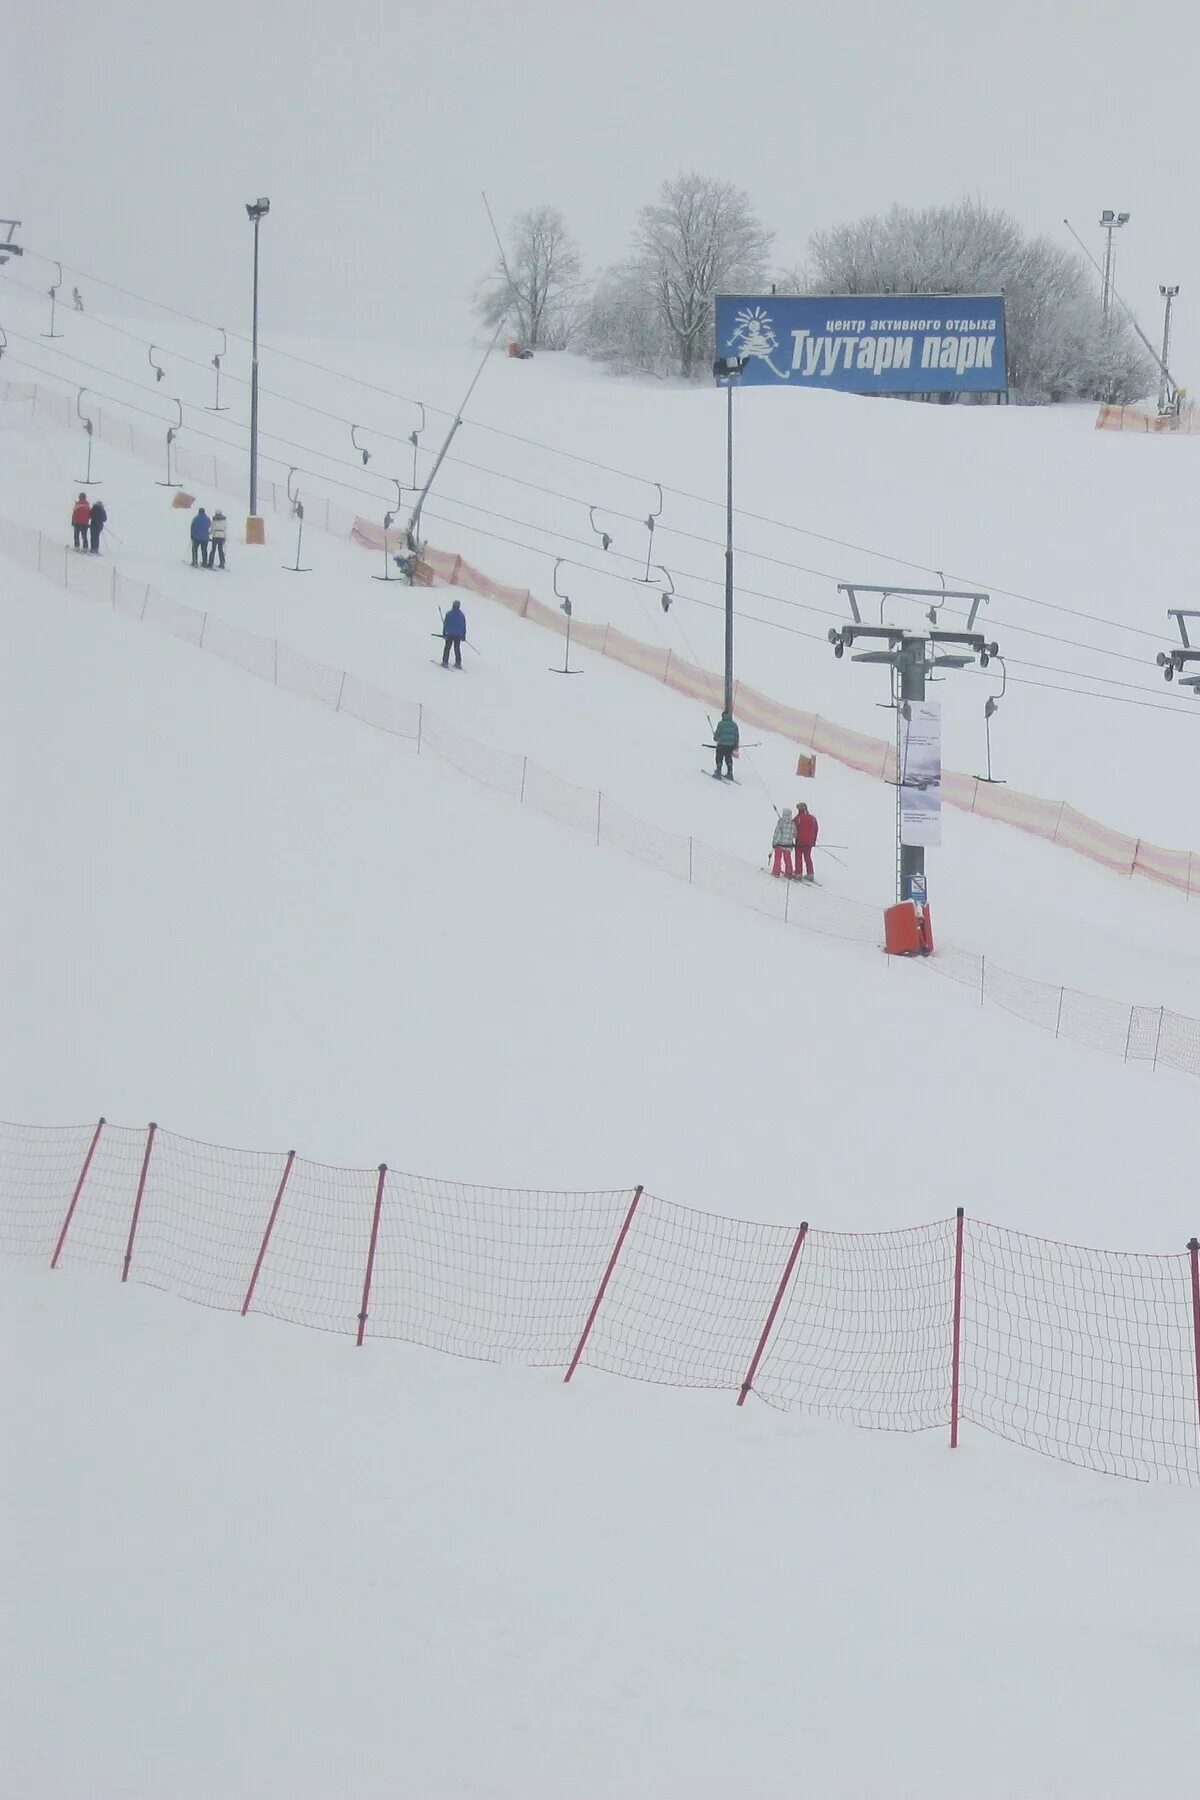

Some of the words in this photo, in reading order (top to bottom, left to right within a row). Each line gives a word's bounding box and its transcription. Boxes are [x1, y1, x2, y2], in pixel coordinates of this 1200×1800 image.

[826, 319, 865, 332] центр
[870, 319, 942, 331] активного
[946, 319, 996, 331] отдыха
[791, 330, 913, 376] Туутари
[921, 336, 996, 375] парк
